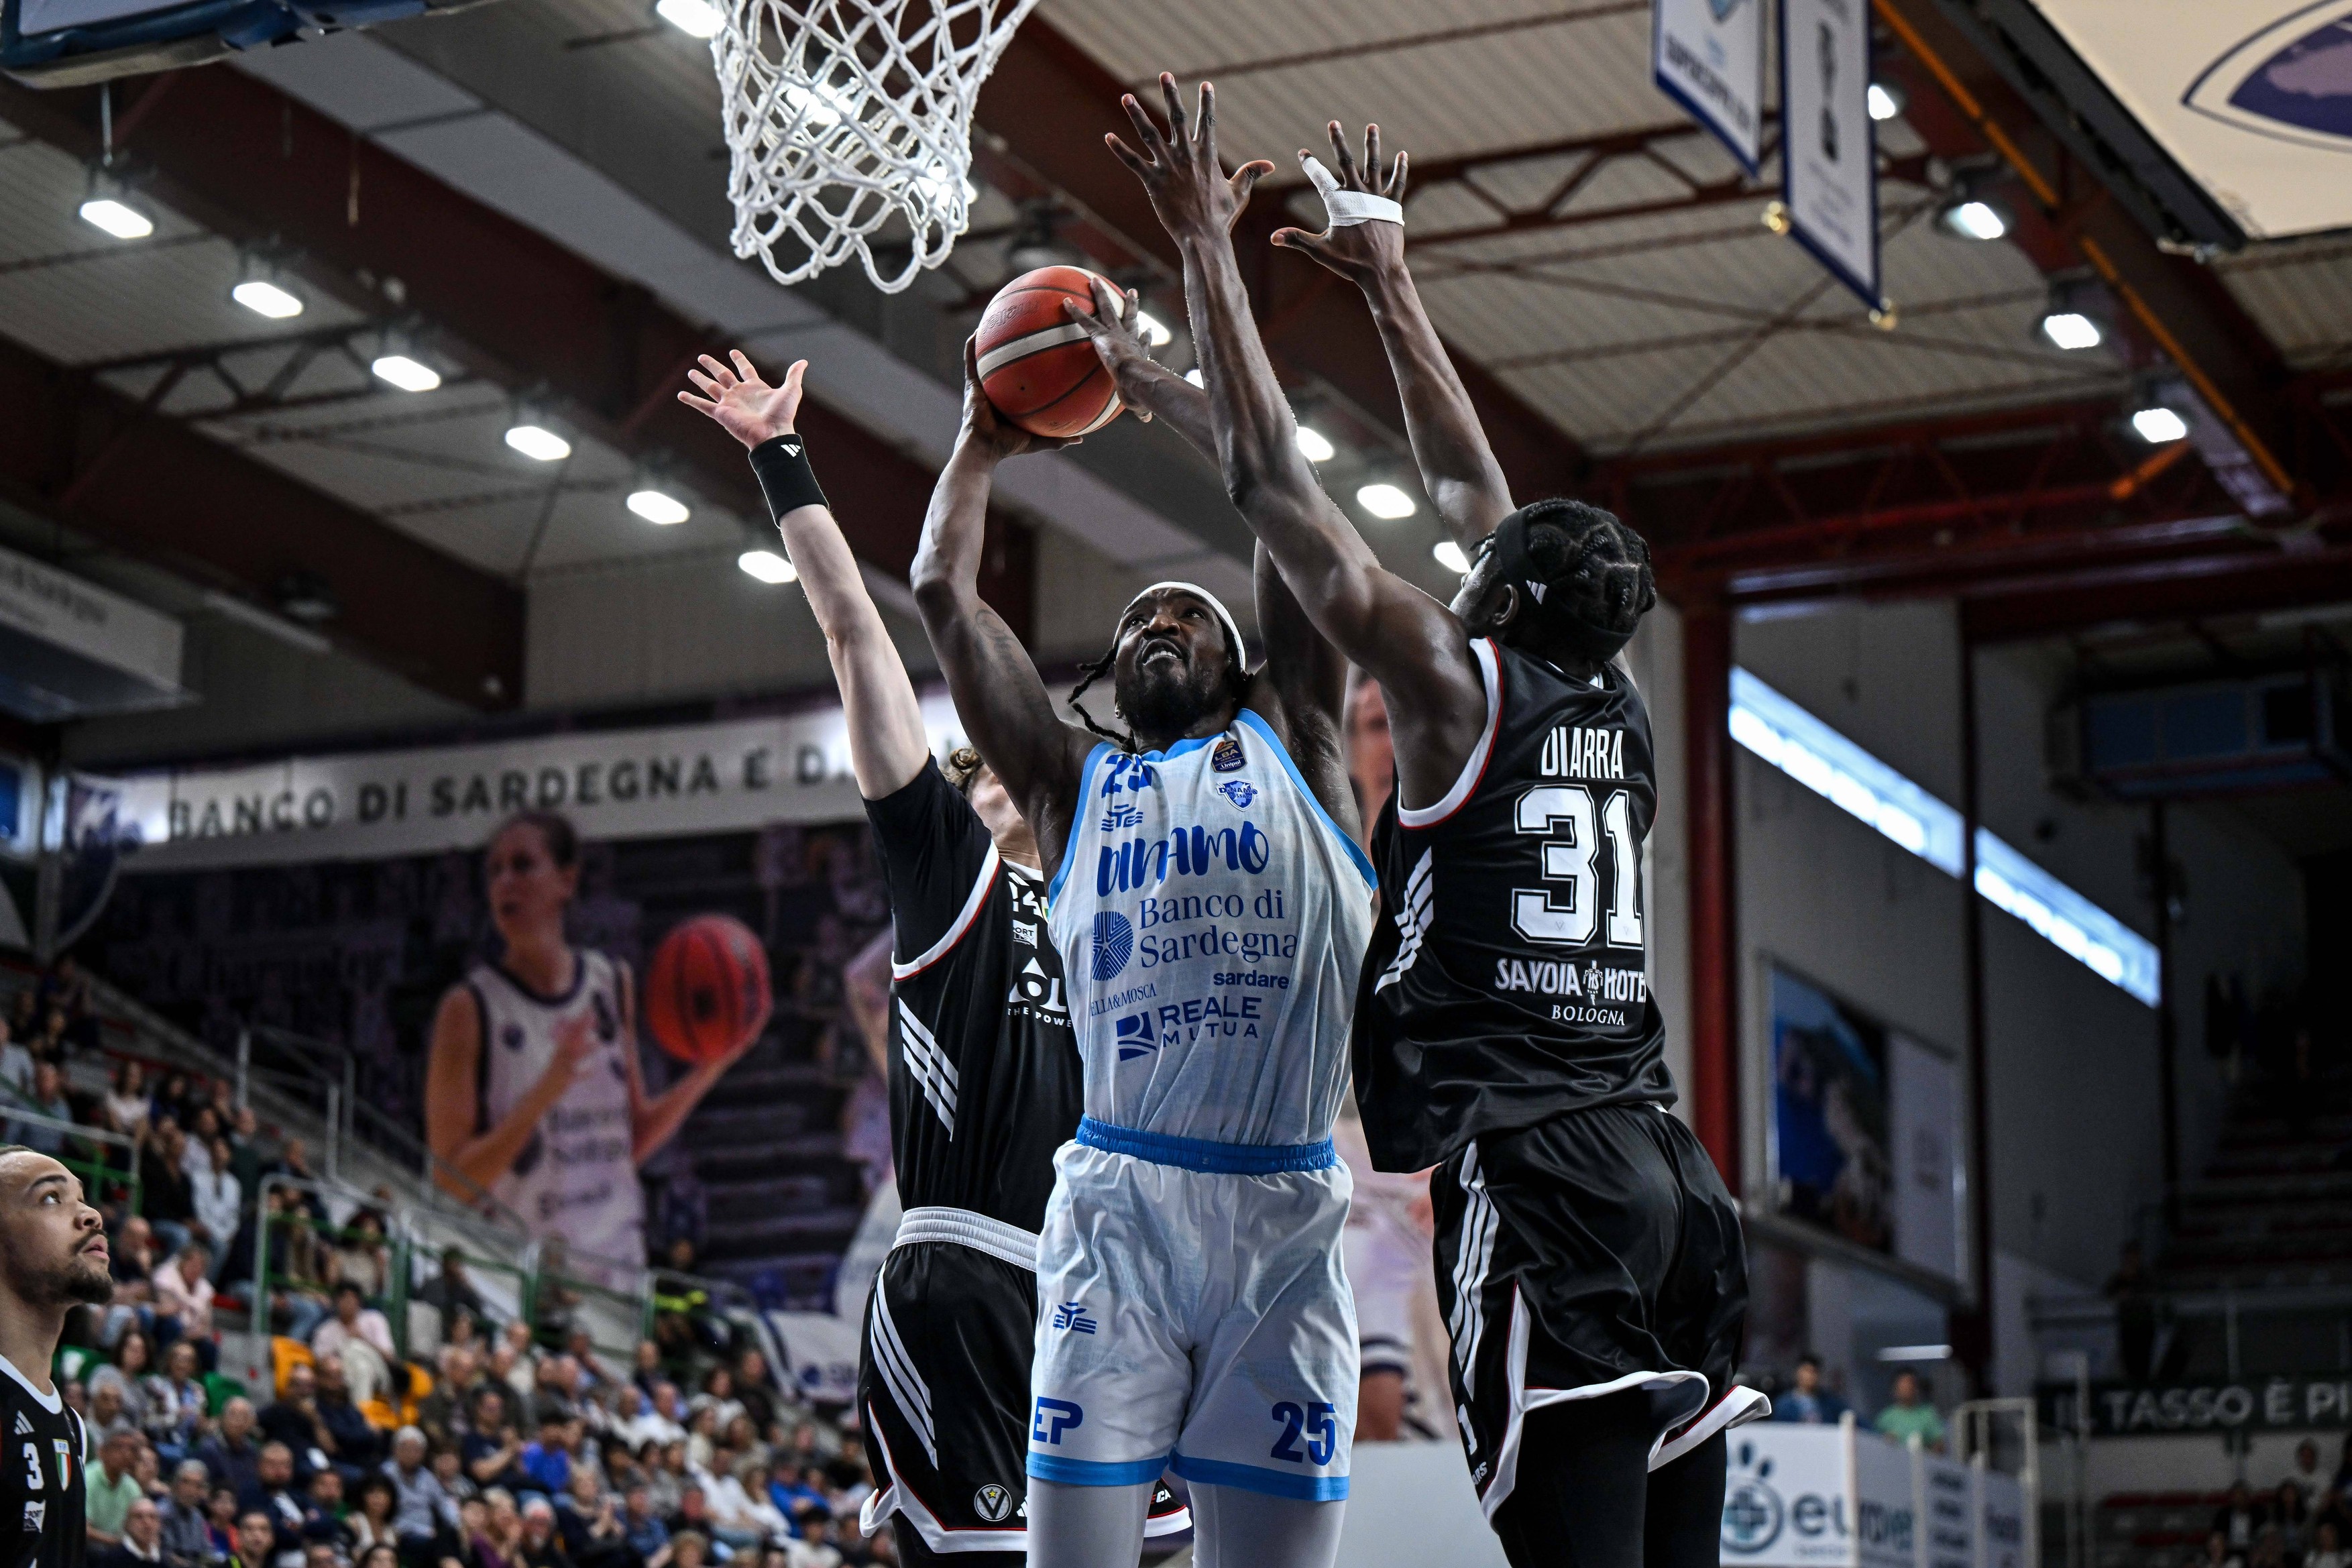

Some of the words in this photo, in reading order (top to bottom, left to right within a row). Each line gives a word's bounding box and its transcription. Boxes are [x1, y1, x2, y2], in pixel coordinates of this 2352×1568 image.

[1215, 748, 1239, 761] LBA
[1221, 759, 1241, 768] Unipol
[1541, 726, 1624, 779] DIARRA
[168, 787, 333, 837] BANCO
[357, 781, 407, 824] DI
[431, 751, 720, 817] SARDEGNA
[1510, 783, 1644, 950] 31
[1139, 894, 1244, 930] Banco
[1254, 889, 1285, 919] di
[1140, 925, 1299, 968] Sardegna
[1495, 958, 1583, 997] SAVOIA
[1158, 995, 1262, 1028] REALE
[1551, 1005, 1625, 1026] BOLOGNA
[1163, 1021, 1258, 1048] MUTUA
[2099, 1385, 2255, 1431] TASSO
[1270, 1401, 1336, 1466] 25
[23, 1443, 44, 1490] 3
